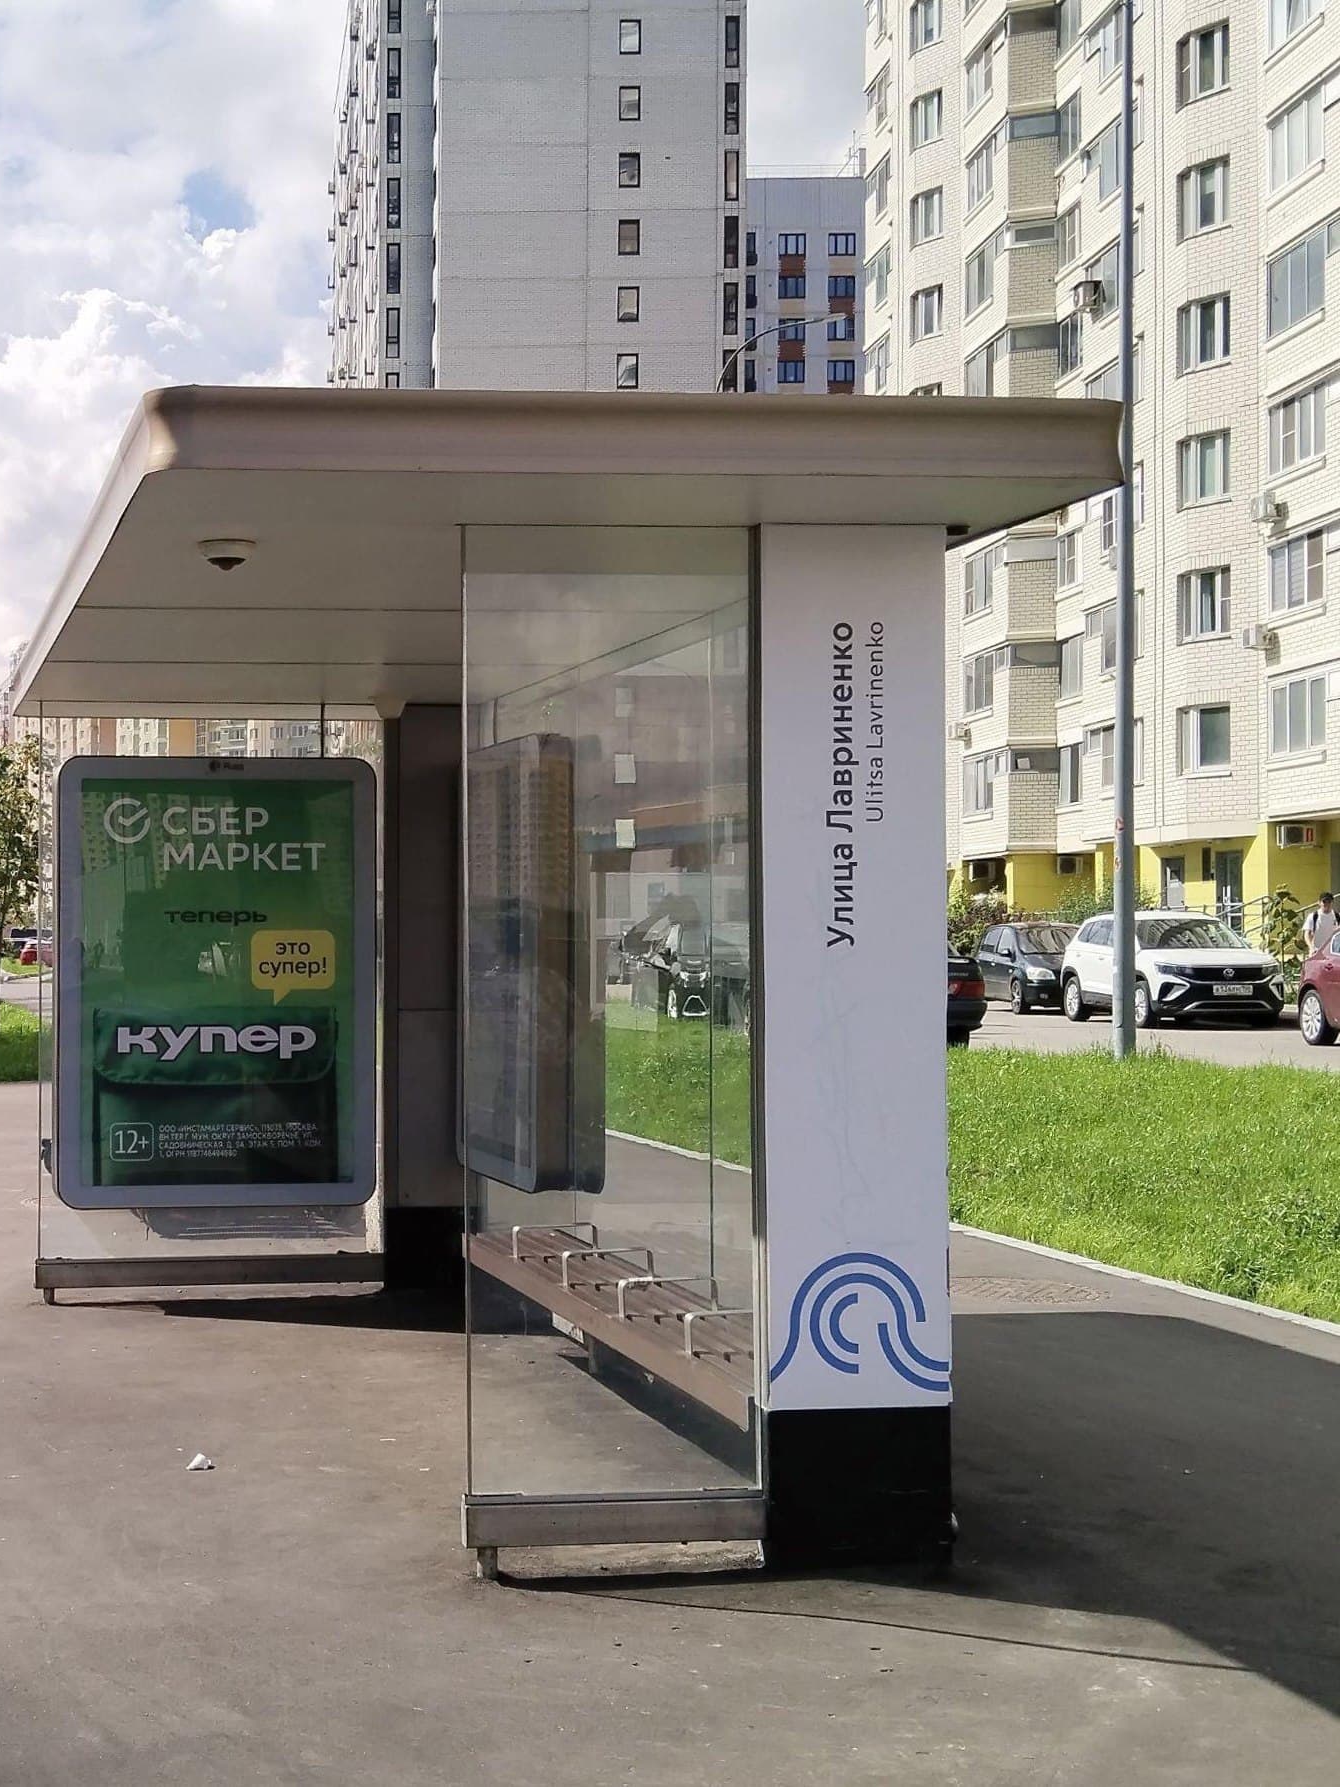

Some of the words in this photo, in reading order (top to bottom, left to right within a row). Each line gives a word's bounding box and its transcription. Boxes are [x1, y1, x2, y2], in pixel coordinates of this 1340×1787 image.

[865, 621, 884, 748] Lavrinenko
[826, 622, 859, 833] Лавриненко
[865, 756, 884, 823] Ulitsa
[162, 806, 269, 836] СБЕР
[163, 842, 326, 871] МАРКЕТ
[827, 843, 857, 947] Улица
[164, 910, 268, 927] теперь
[276, 942, 311, 955] это
[259, 956, 327, 978] супер!
[116, 1024, 317, 1061] купер
[114, 1129, 150, 1154] 12+
